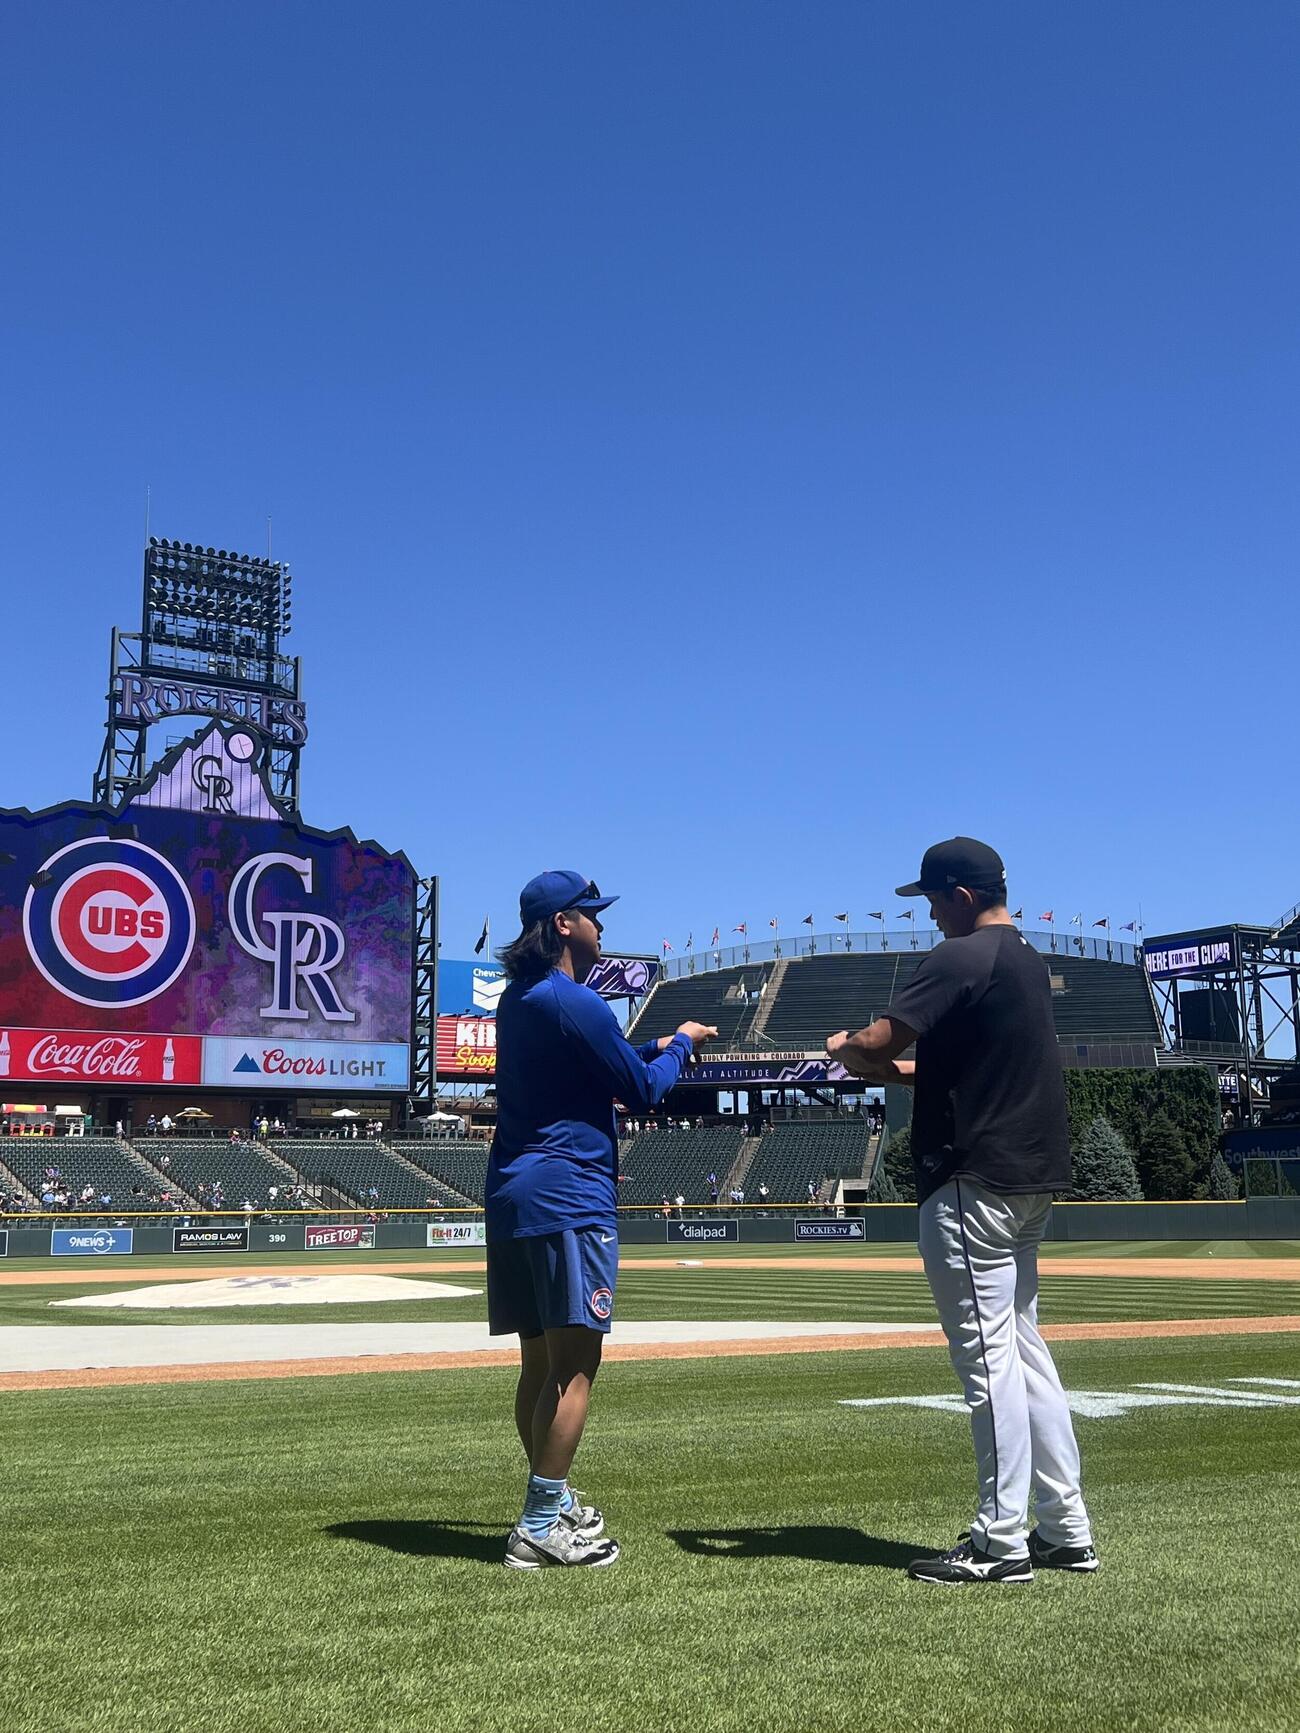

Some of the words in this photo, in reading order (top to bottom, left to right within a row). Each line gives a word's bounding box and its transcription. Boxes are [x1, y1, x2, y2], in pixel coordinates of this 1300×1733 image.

[112, 675, 308, 745] ROCKIES
[1145, 951, 1168, 972] HERE
[1171, 952, 1183, 965] FOR
[1184, 951, 1196, 963] THE
[27, 1034, 147, 1076] Coca-Cola
[726, 1053, 760, 1061] POWERING
[771, 1052, 805, 1060] COLORADO
[263, 1048, 327, 1075] Coors
[330, 1059, 386, 1077] LIGHT
[703, 1070, 712, 1078] AT
[721, 1069, 769, 1078] ALTITUDE
[180, 1233, 218, 1241] RAMOS
[219, 1232, 242, 1241] LAW
[269, 1234, 286, 1243] 390
[453, 1227, 471, 1238] 24/7
[683, 1225, 726, 1240] dialpad
